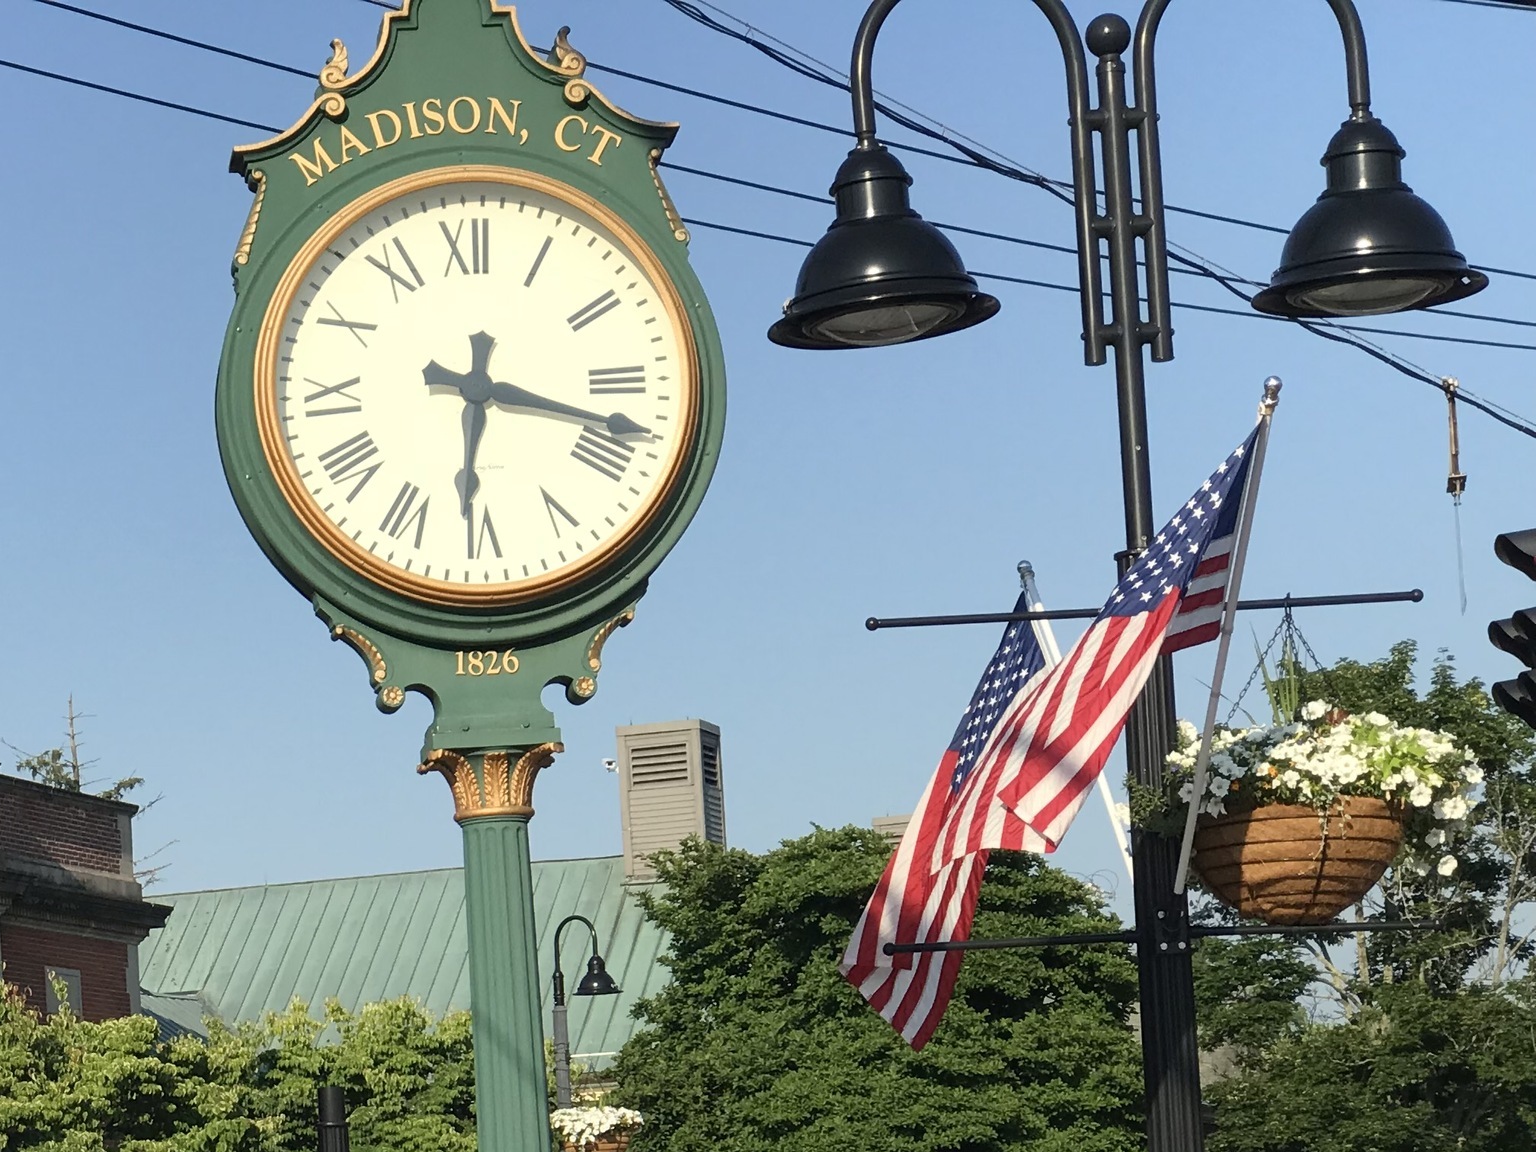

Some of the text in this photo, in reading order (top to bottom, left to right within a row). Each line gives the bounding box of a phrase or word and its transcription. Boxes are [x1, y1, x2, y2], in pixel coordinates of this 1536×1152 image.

[288, 96, 623, 187] MADISON, CT
[364, 236, 426, 304] XI
[438, 217, 490, 278] XII
[523, 235, 553, 288] I
[316, 300, 378, 349] X
[566, 288, 622, 332] II
[303, 375, 362, 418] IX
[588, 365, 646, 395] III
[318, 429, 385, 504] VIII
[378, 480, 431, 550] VII
[467, 501, 503, 560] VI
[539, 485, 580, 539] V
[455, 647, 520, 676] 1826
